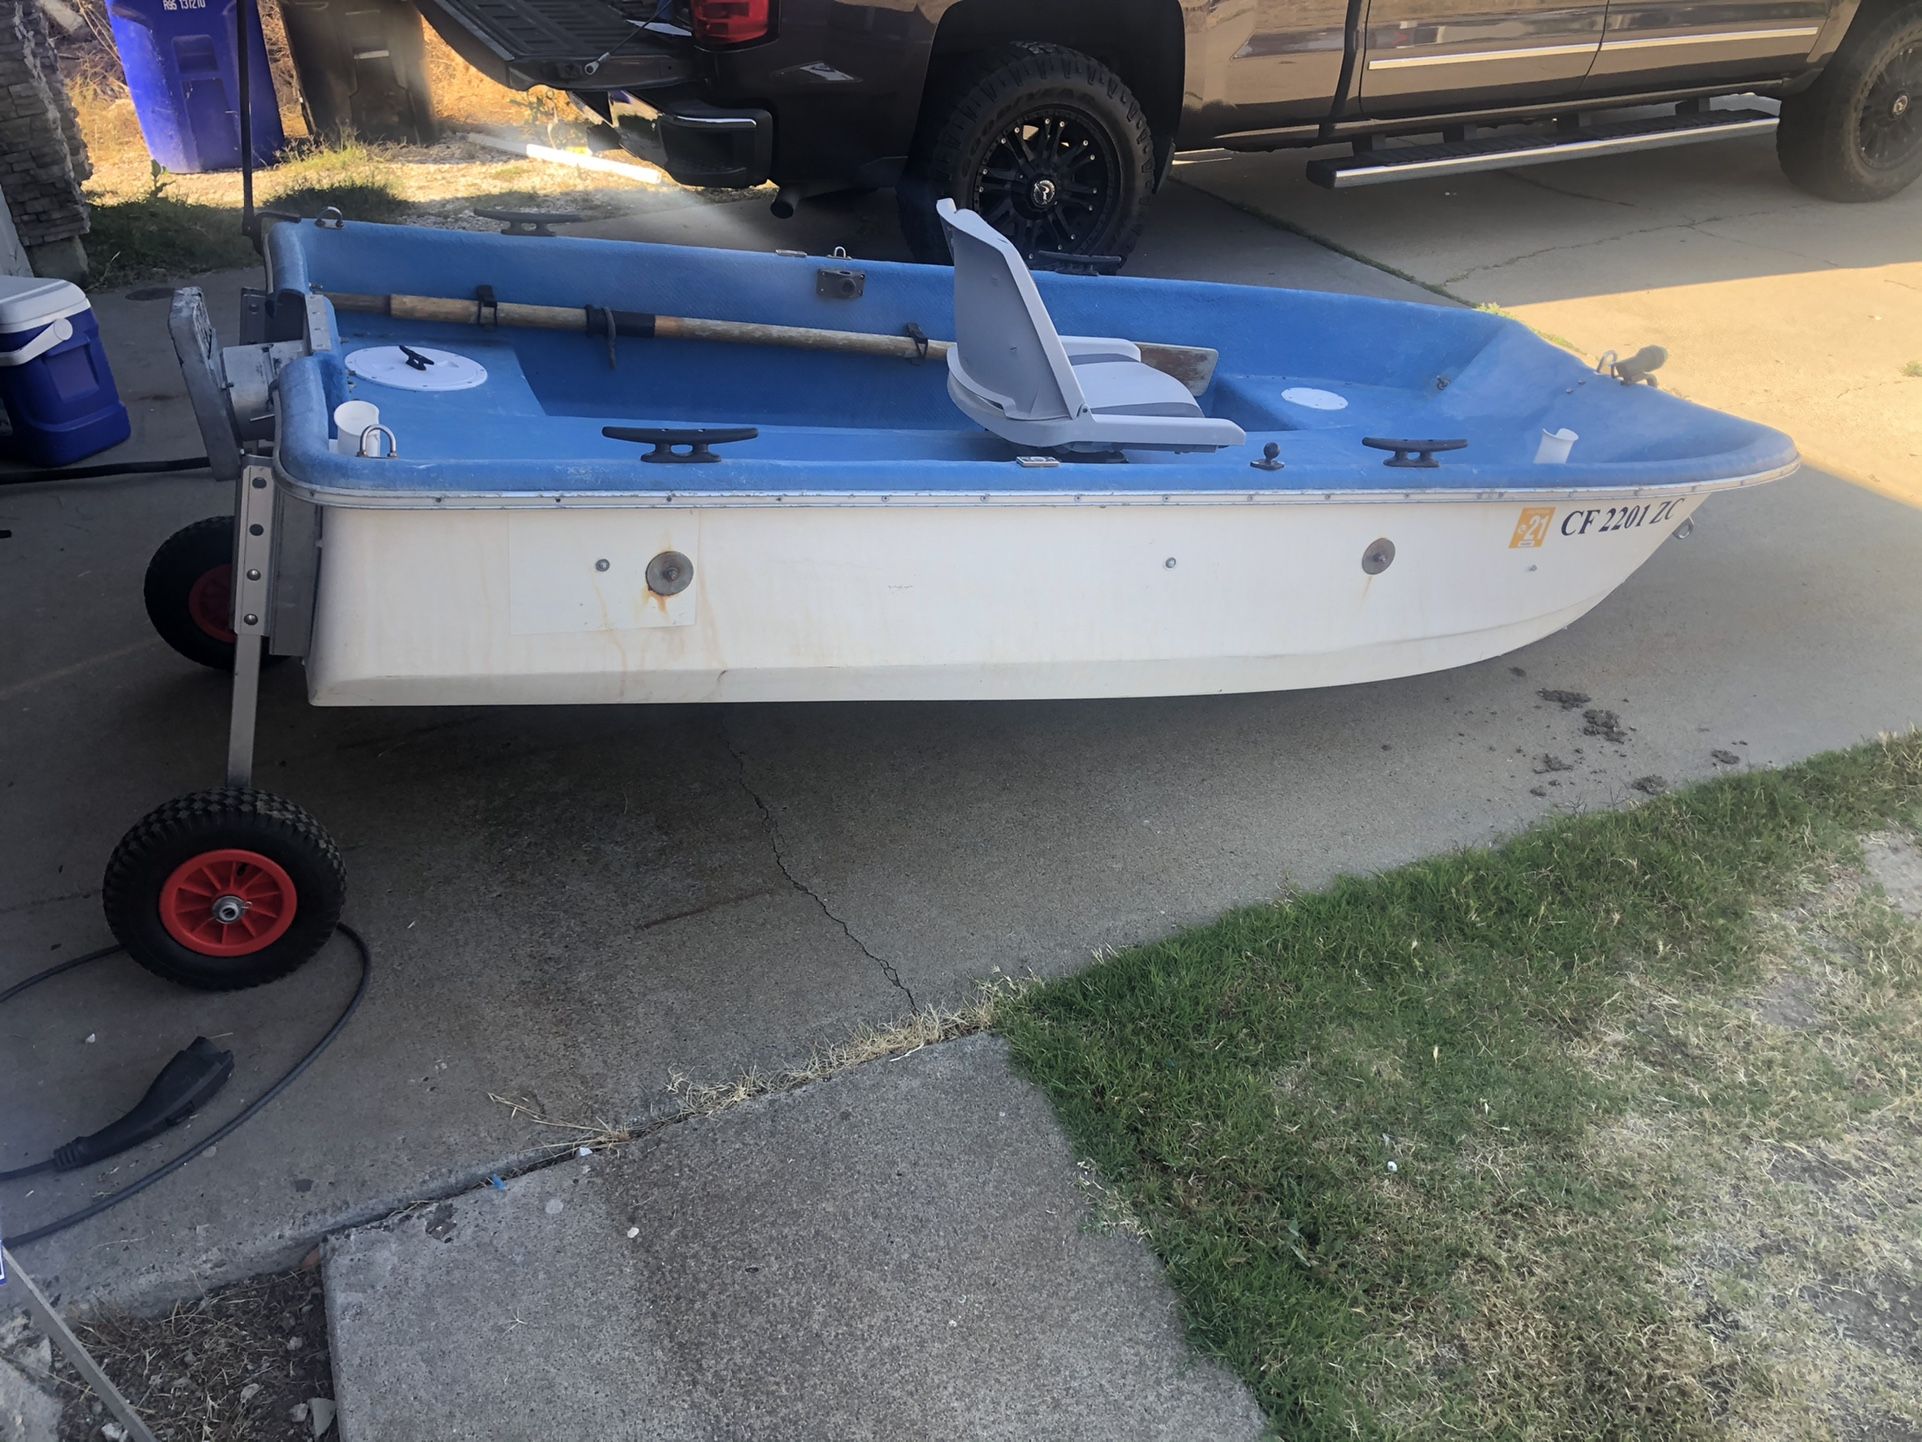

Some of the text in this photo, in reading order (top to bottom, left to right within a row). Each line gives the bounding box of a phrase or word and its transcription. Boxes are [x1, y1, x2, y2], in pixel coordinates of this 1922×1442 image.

[1561, 498, 1685, 536] CF 2201 ZC
